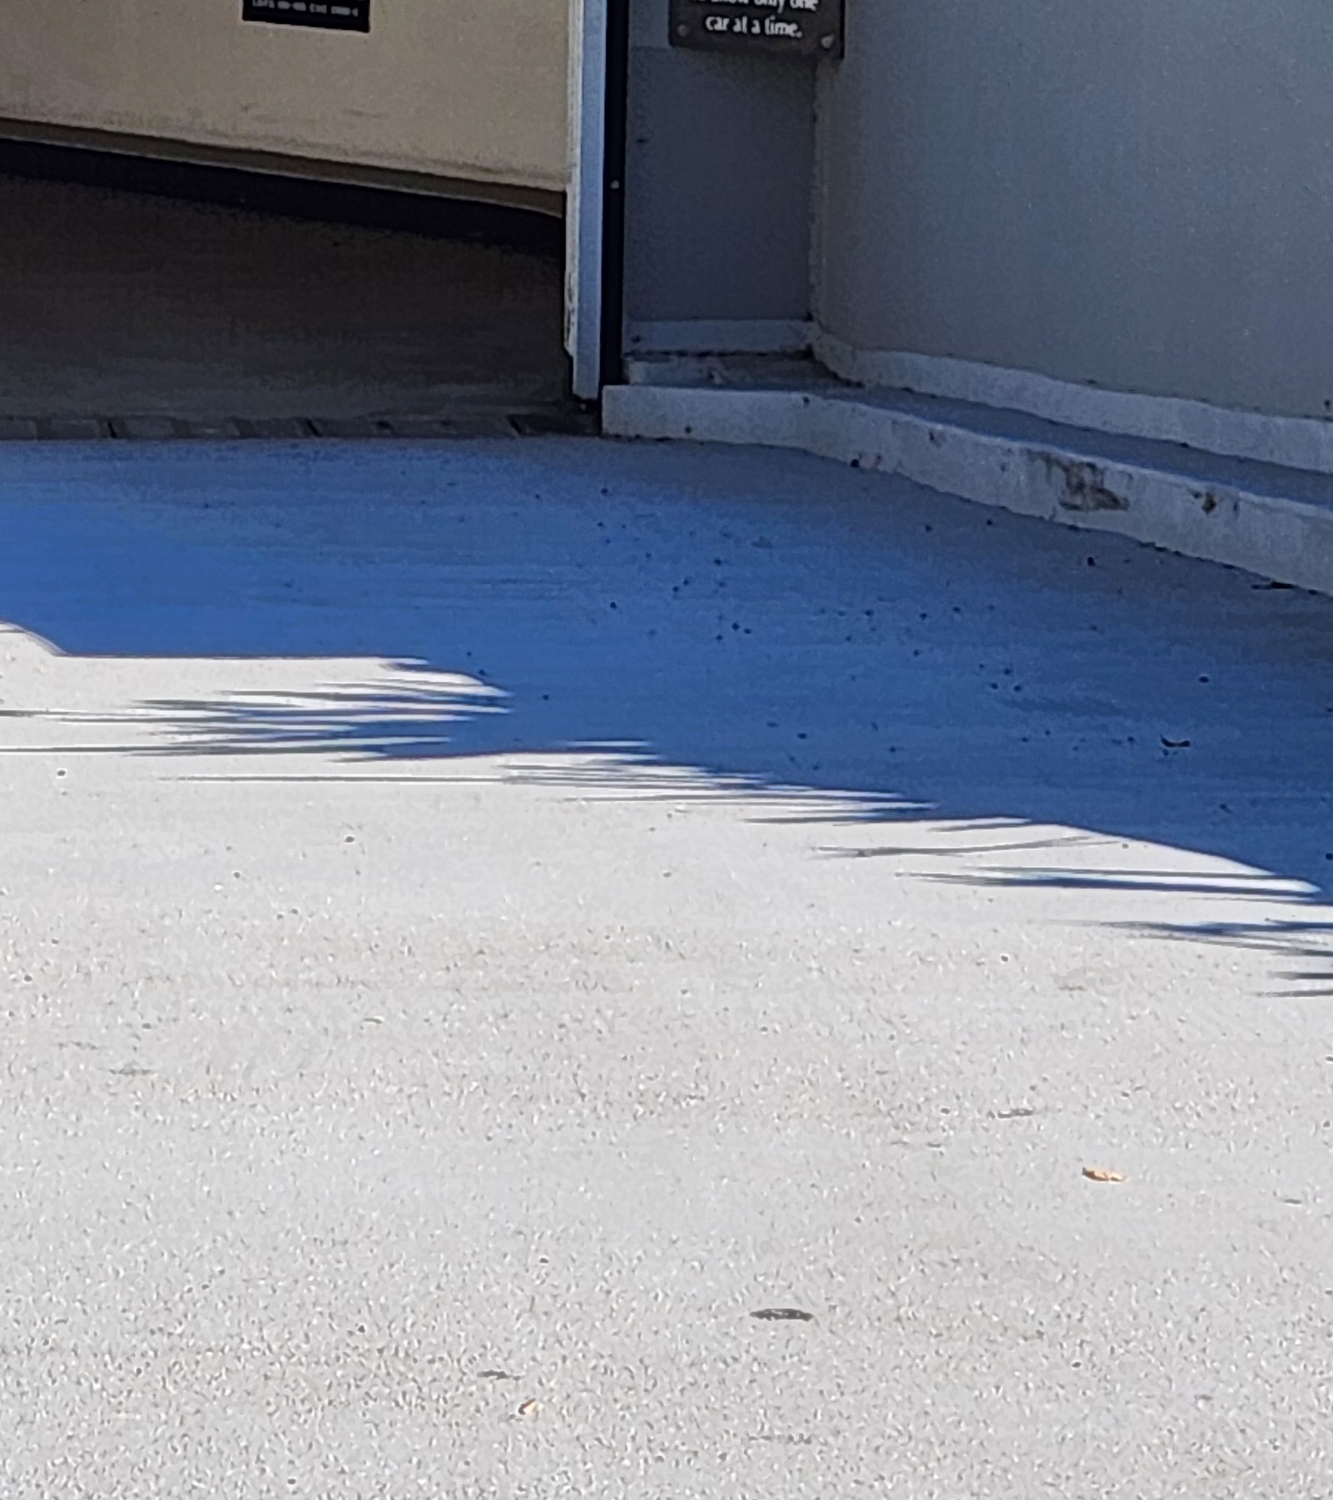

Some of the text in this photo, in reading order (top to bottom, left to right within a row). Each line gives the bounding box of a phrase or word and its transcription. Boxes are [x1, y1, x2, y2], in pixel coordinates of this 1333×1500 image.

[706, 15, 802, 38] car at a time.
